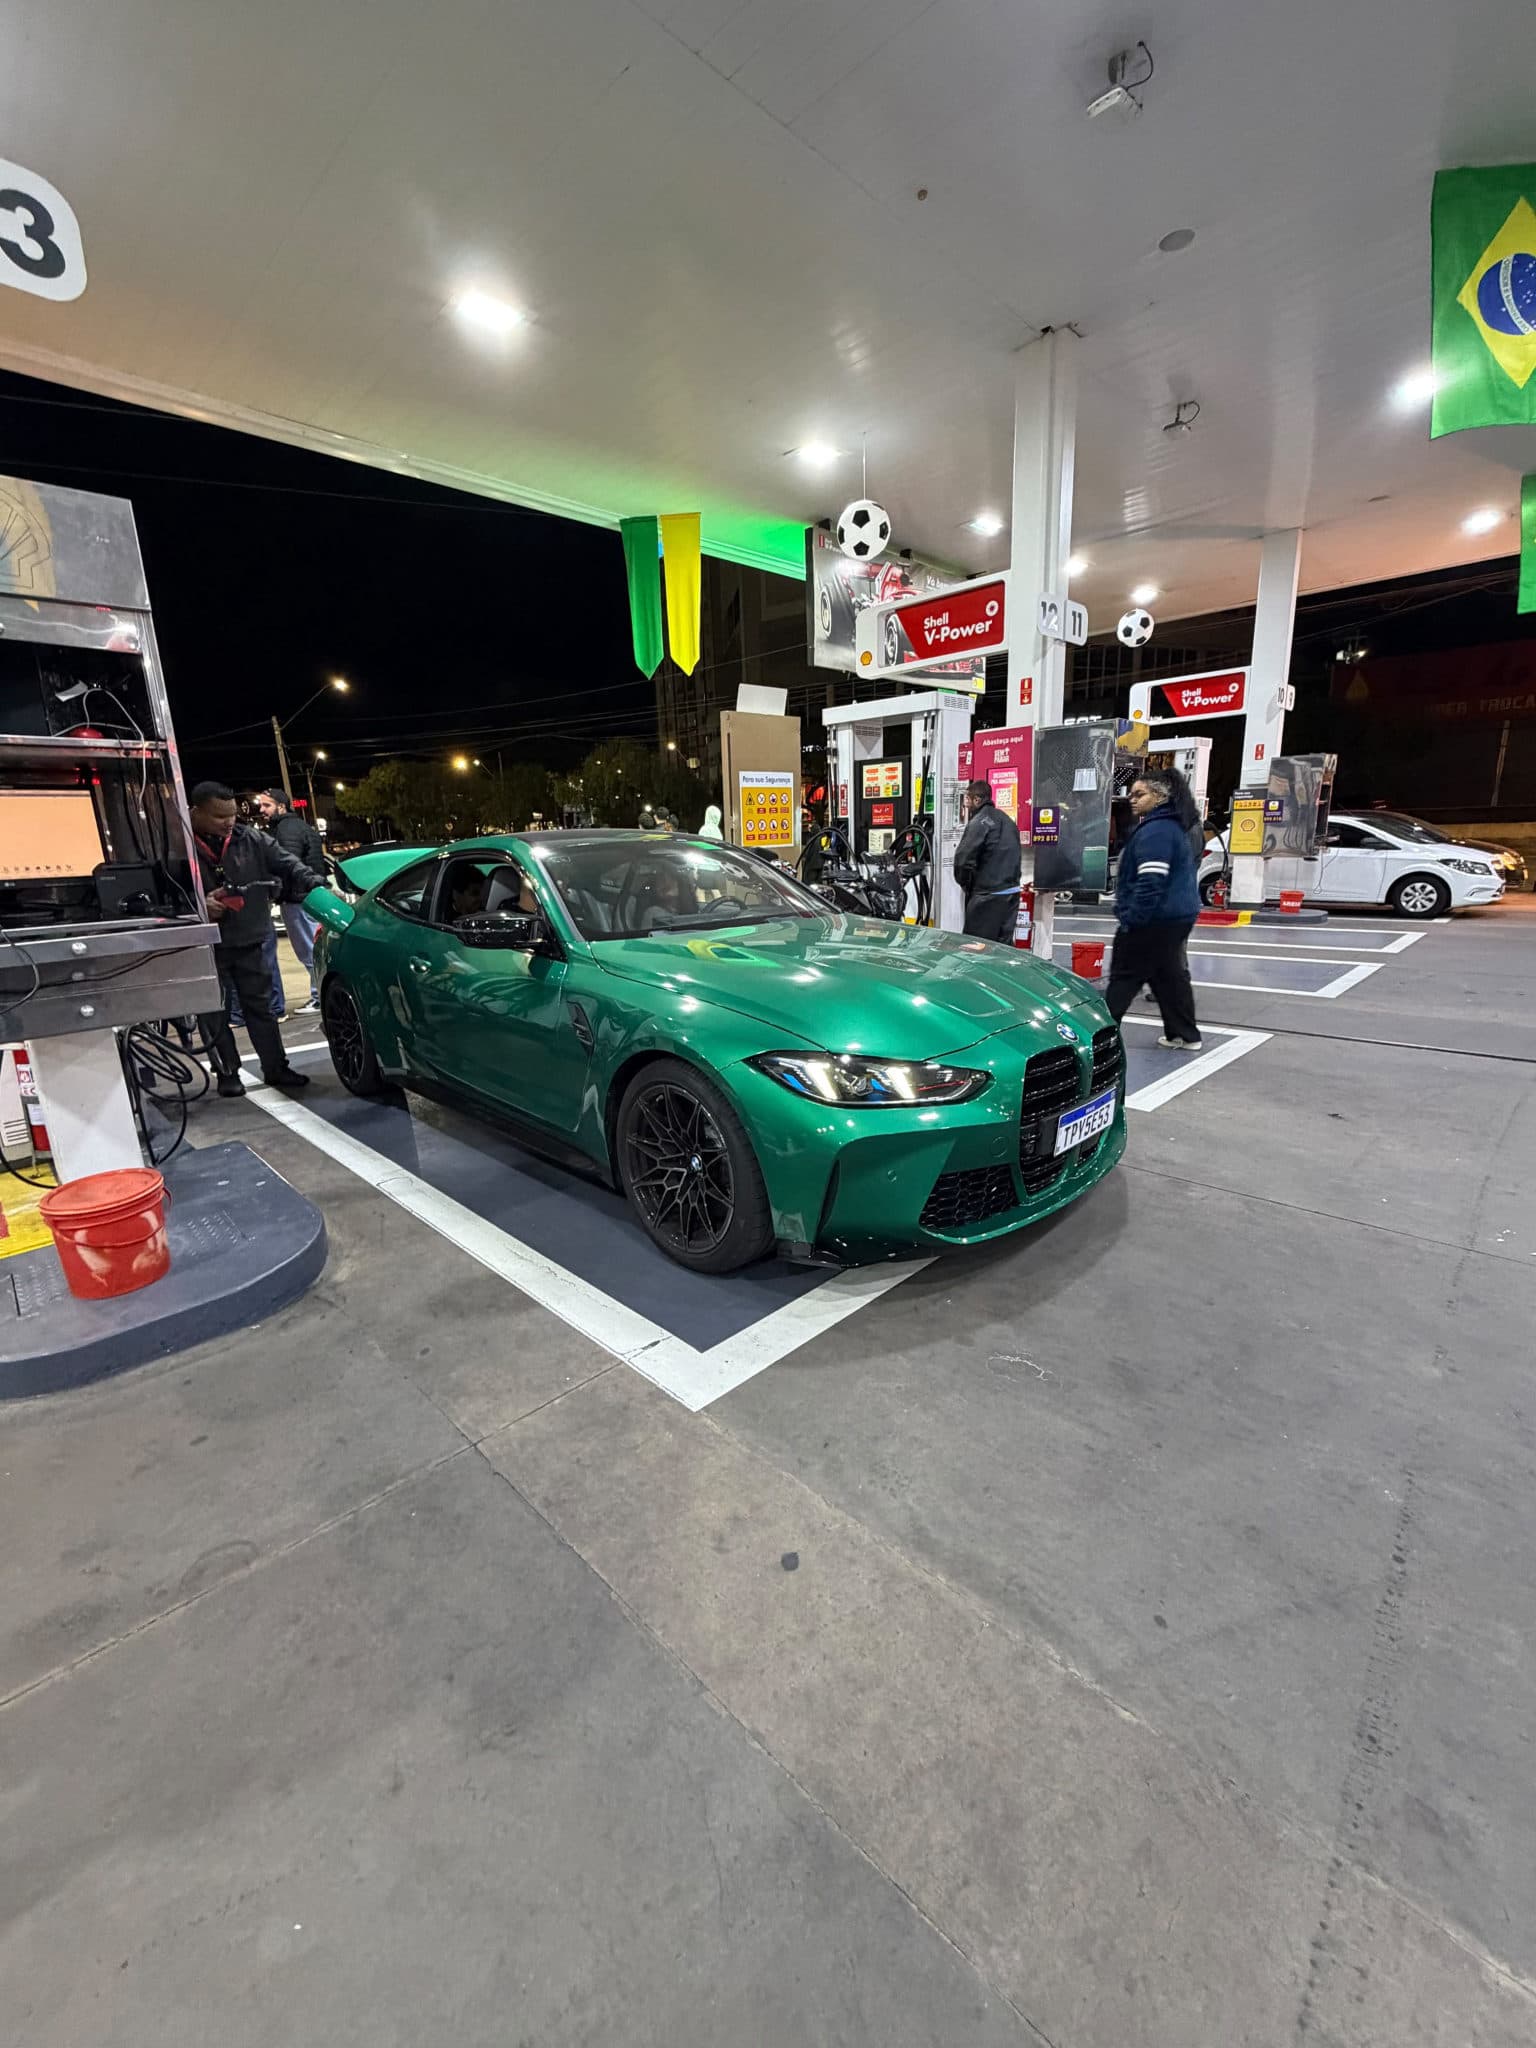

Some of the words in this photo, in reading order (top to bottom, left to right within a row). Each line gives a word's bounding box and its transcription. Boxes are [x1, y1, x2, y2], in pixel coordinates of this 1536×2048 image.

[923, 612, 949, 630] Shell
[1040, 600, 1058, 632] 12
[1071, 610, 1083, 638] 11
[924, 619, 993, 646] V-Power
[1181, 687, 1202, 698] Shell
[1182, 693, 1235, 708] V-Power
[1010, 734, 1023, 744] aqui
